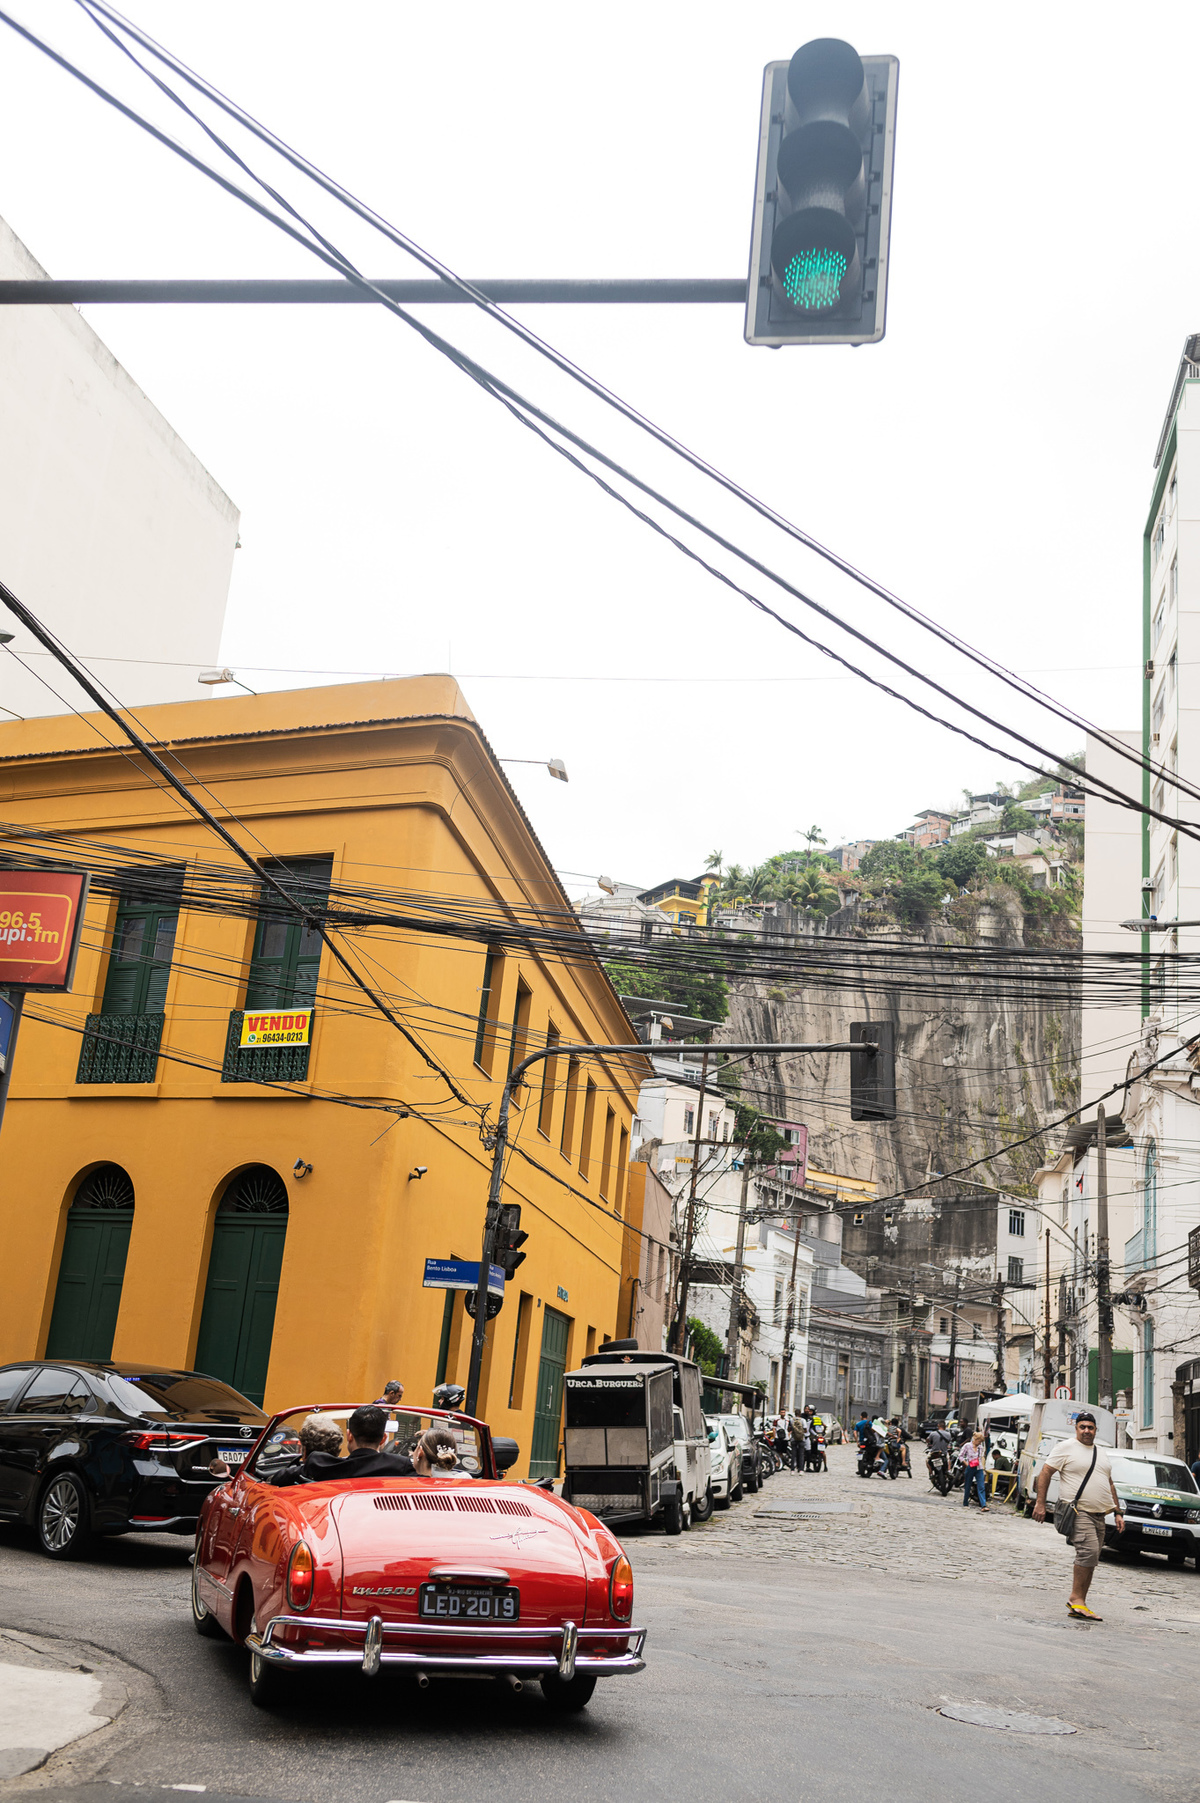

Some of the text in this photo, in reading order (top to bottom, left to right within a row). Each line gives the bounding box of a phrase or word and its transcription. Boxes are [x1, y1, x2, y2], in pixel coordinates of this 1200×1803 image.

[0, 911, 42, 929] 96.5
[248, 1014, 307, 1031] VENDO
[262, 1032, 303, 1043] 96434-0213
